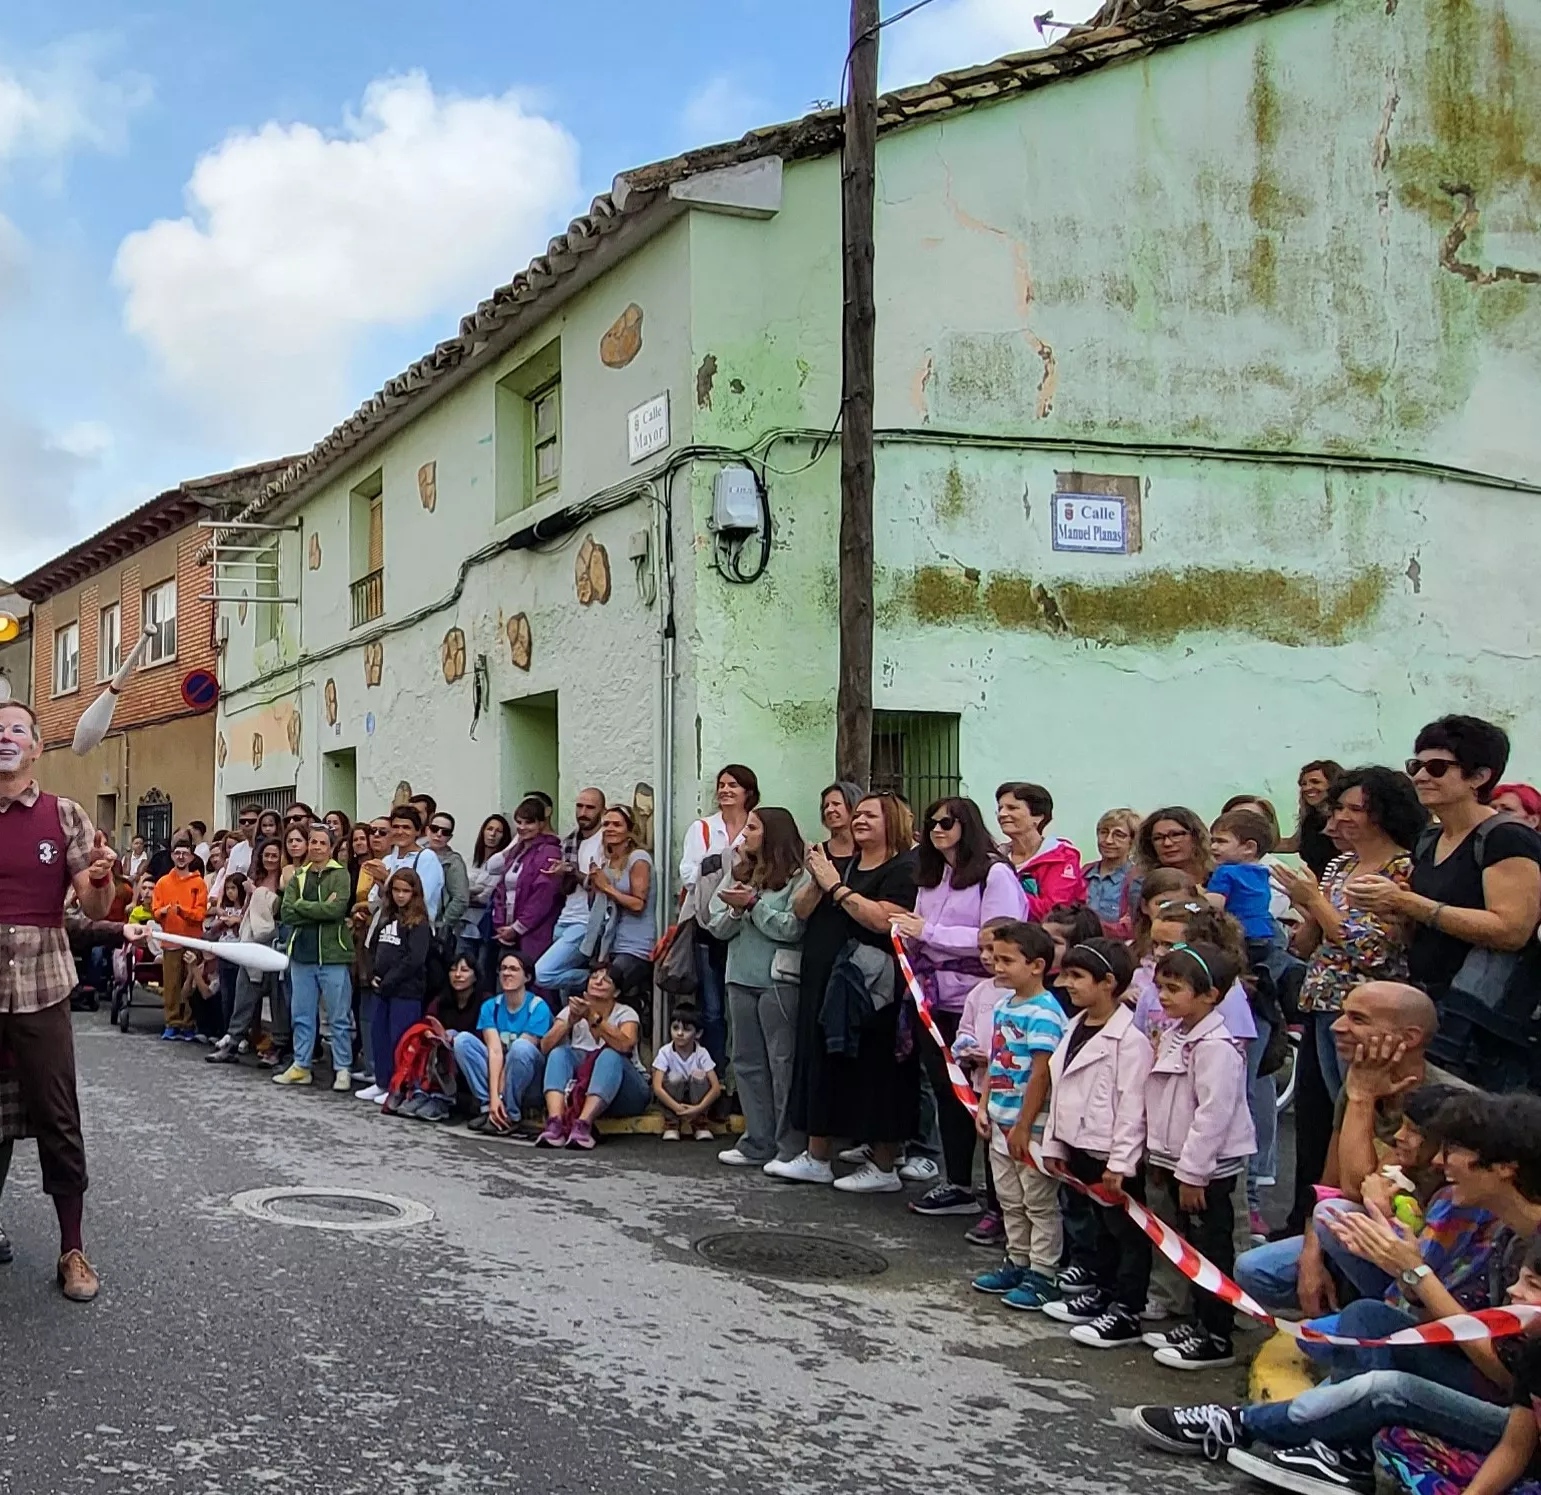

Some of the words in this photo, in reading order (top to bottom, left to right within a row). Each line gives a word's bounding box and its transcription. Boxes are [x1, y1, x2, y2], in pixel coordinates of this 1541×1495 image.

[642, 405, 662, 425] Calle
[634, 426, 664, 449] Mayor
[1081, 505, 1116, 520] Calle
[1059, 523, 1091, 541] Manuel
[1093, 525, 1122, 542] Planas
